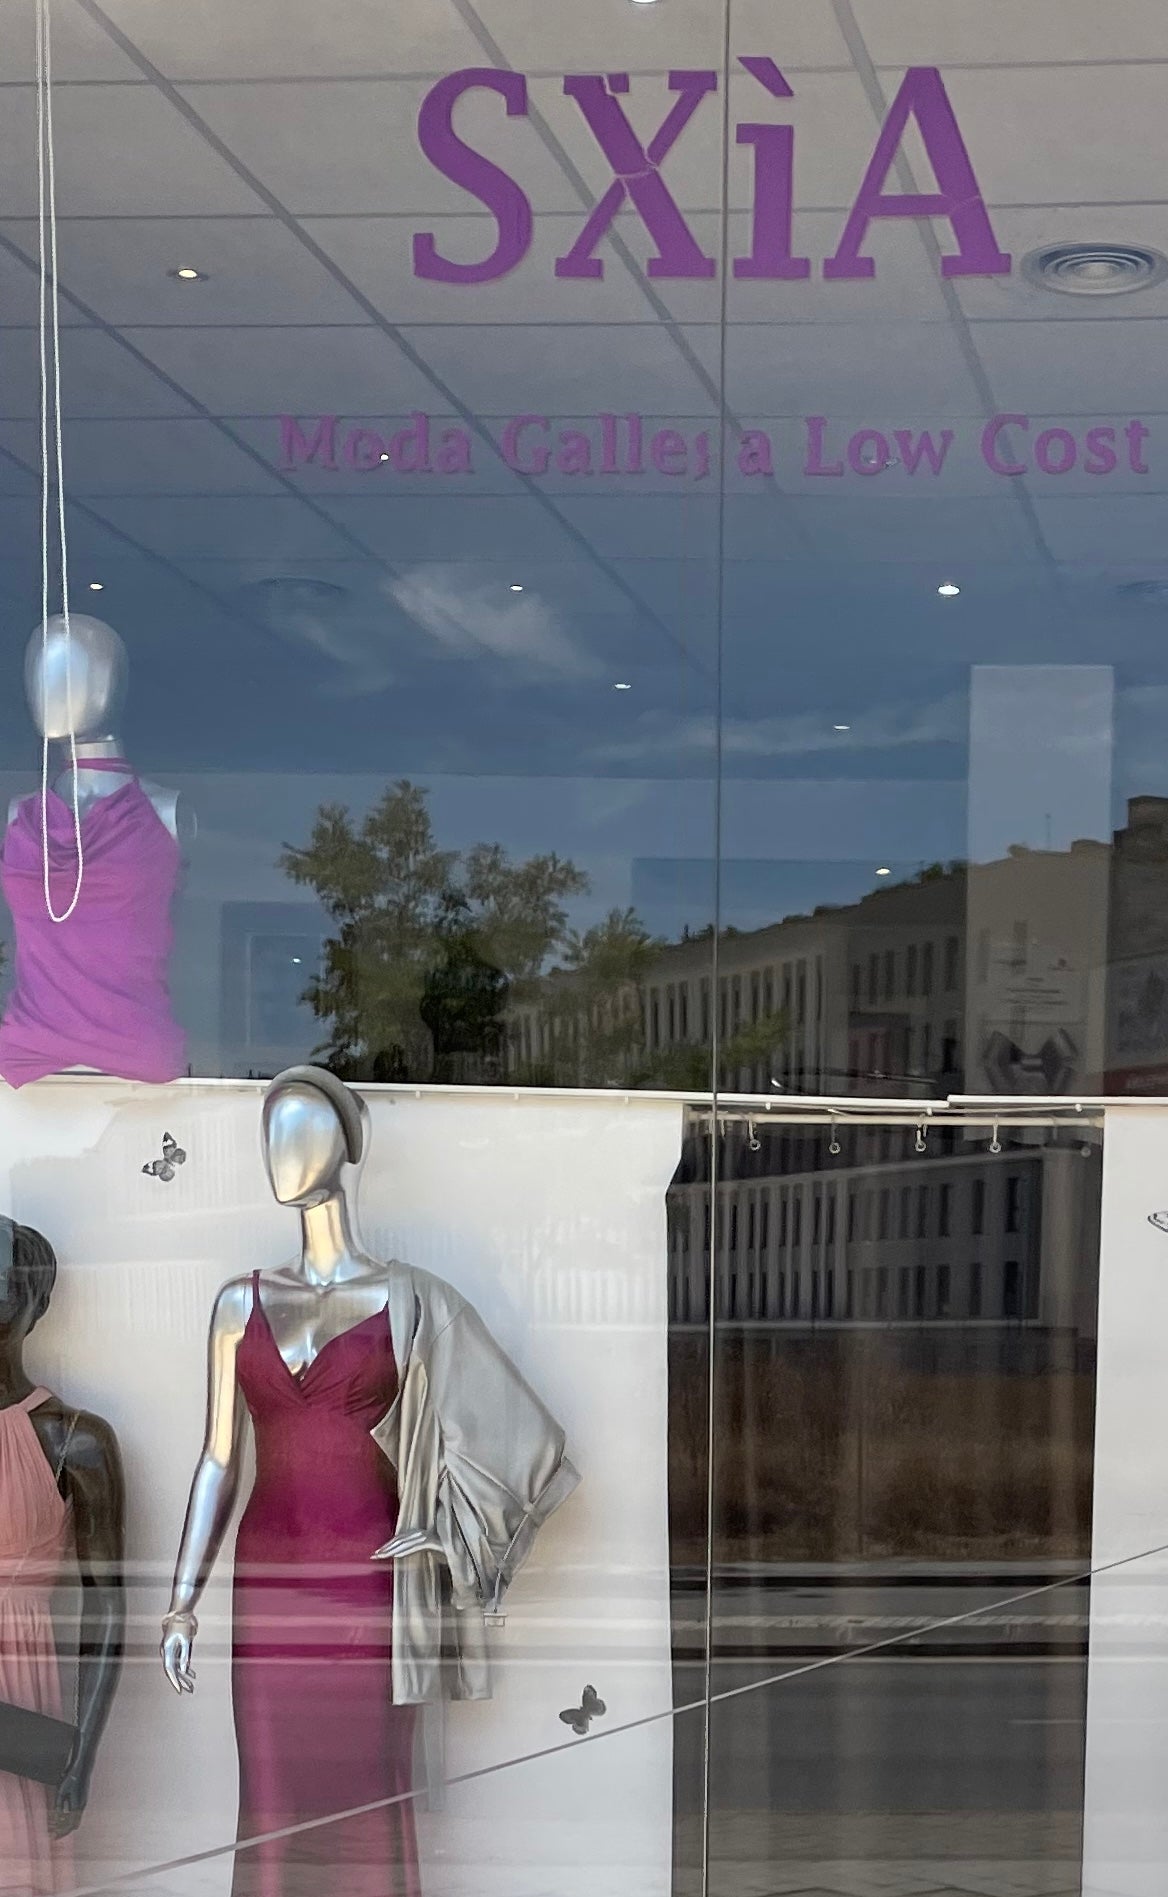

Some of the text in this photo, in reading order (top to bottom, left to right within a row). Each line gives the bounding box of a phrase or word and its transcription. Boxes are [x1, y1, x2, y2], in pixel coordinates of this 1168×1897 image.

[413, 56, 1011, 285] SXìA
[277, 412, 473, 476] Moda
[803, 415, 954, 477] Low
[980, 413, 1150, 477] Cost
